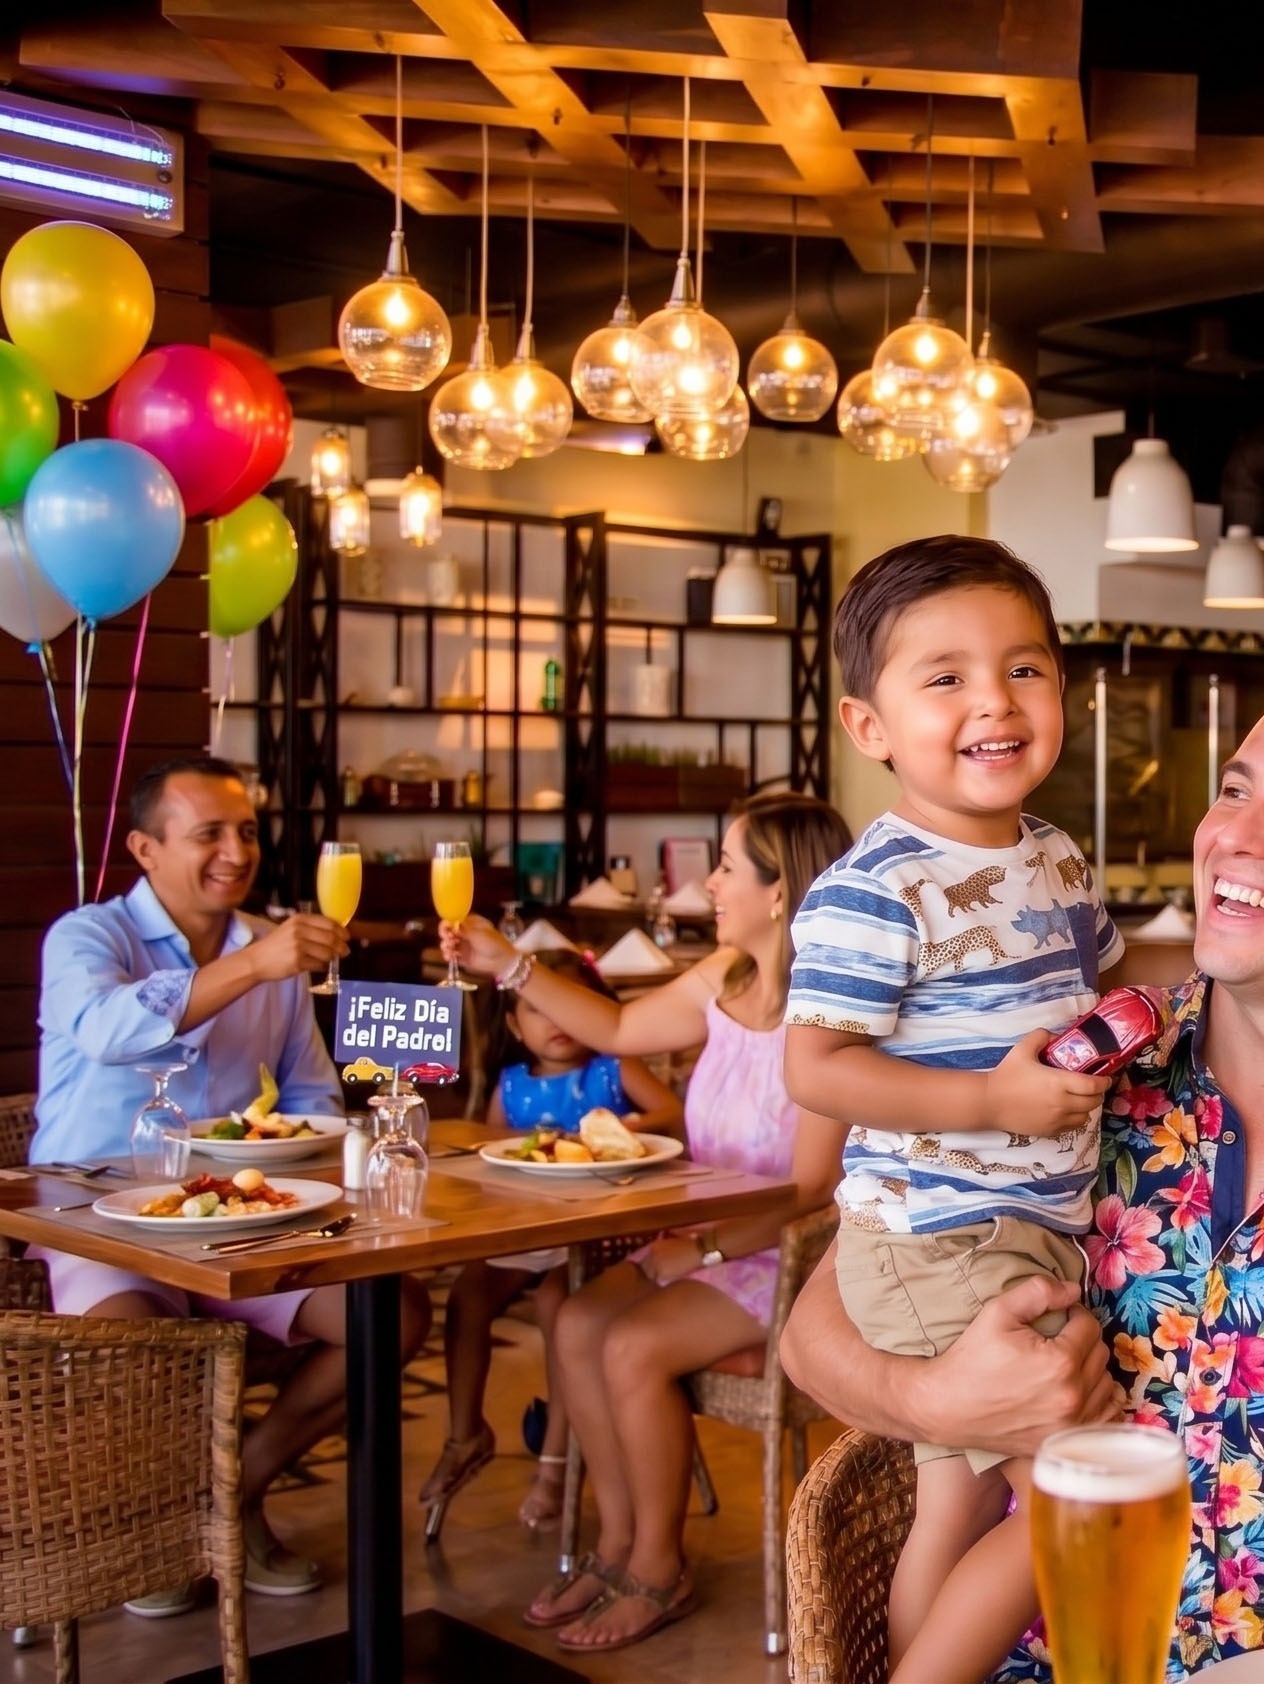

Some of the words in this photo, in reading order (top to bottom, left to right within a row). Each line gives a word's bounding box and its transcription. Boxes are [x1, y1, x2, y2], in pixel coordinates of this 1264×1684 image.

[348, 995, 407, 1022] ¡Feliz
[413, 999, 450, 1024] Día
[342, 1023, 377, 1048] del
